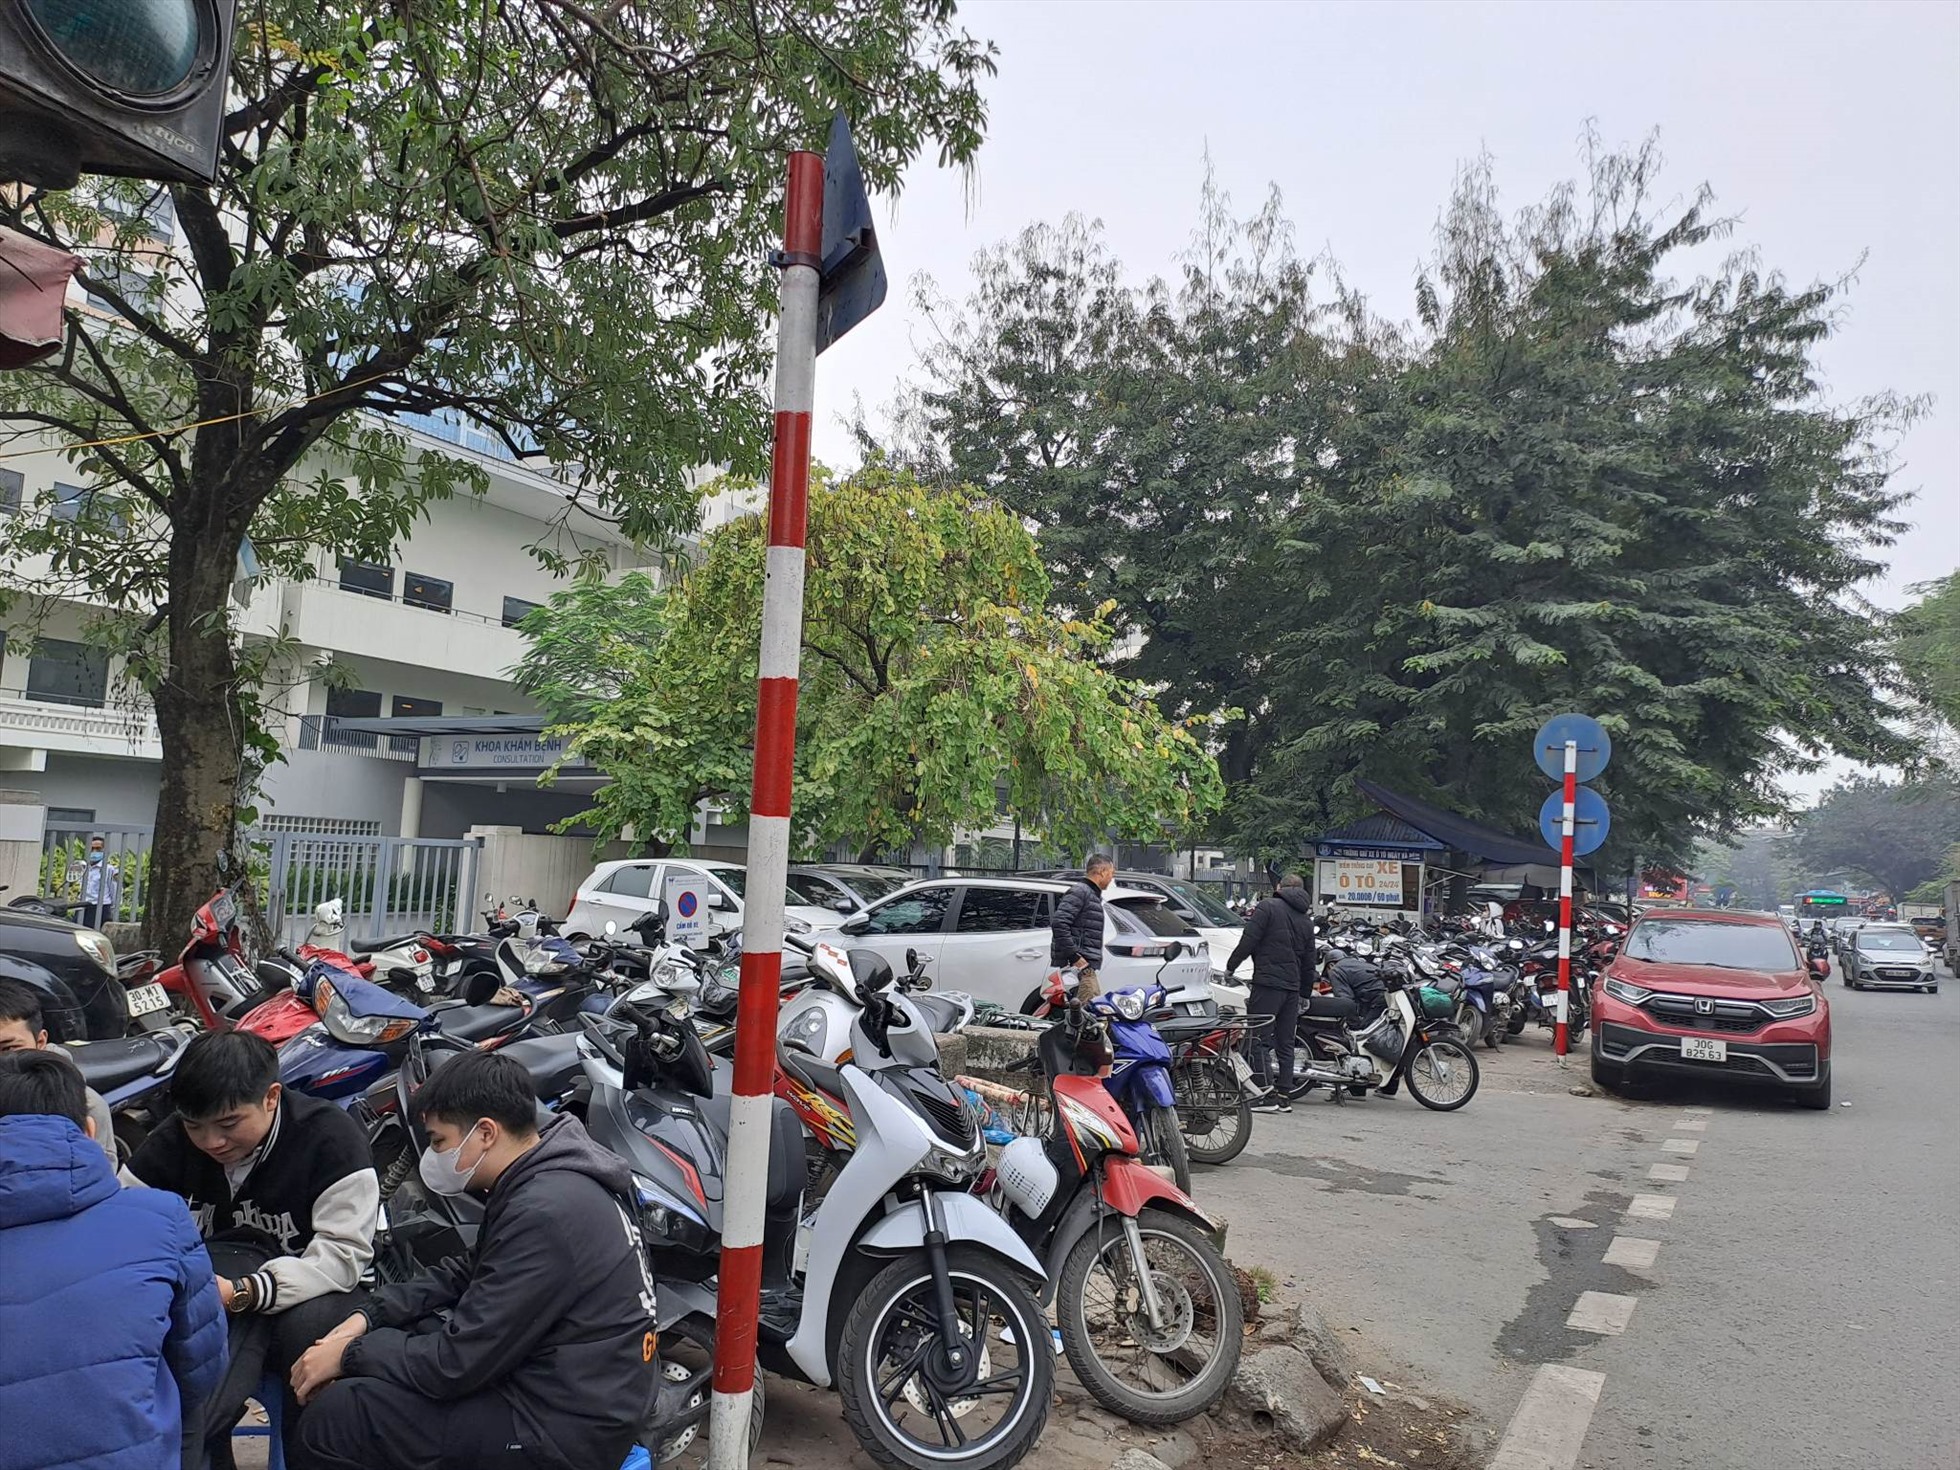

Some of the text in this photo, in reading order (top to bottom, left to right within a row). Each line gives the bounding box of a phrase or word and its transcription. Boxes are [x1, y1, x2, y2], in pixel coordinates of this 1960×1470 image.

[475, 740, 501, 752] KHOA
[503, 737, 532, 752] KHÁM
[493, 754, 545, 764] CONSULTATION
[1376, 861, 1398, 874] XE
[1340, 872, 1350, 888] Ô
[1355, 872, 1376, 888] TÔ
[134, 996, 164, 1012] 5215
[1694, 1040, 1714, 1050] 30G
[1686, 1048, 1722, 1060] 825.63
